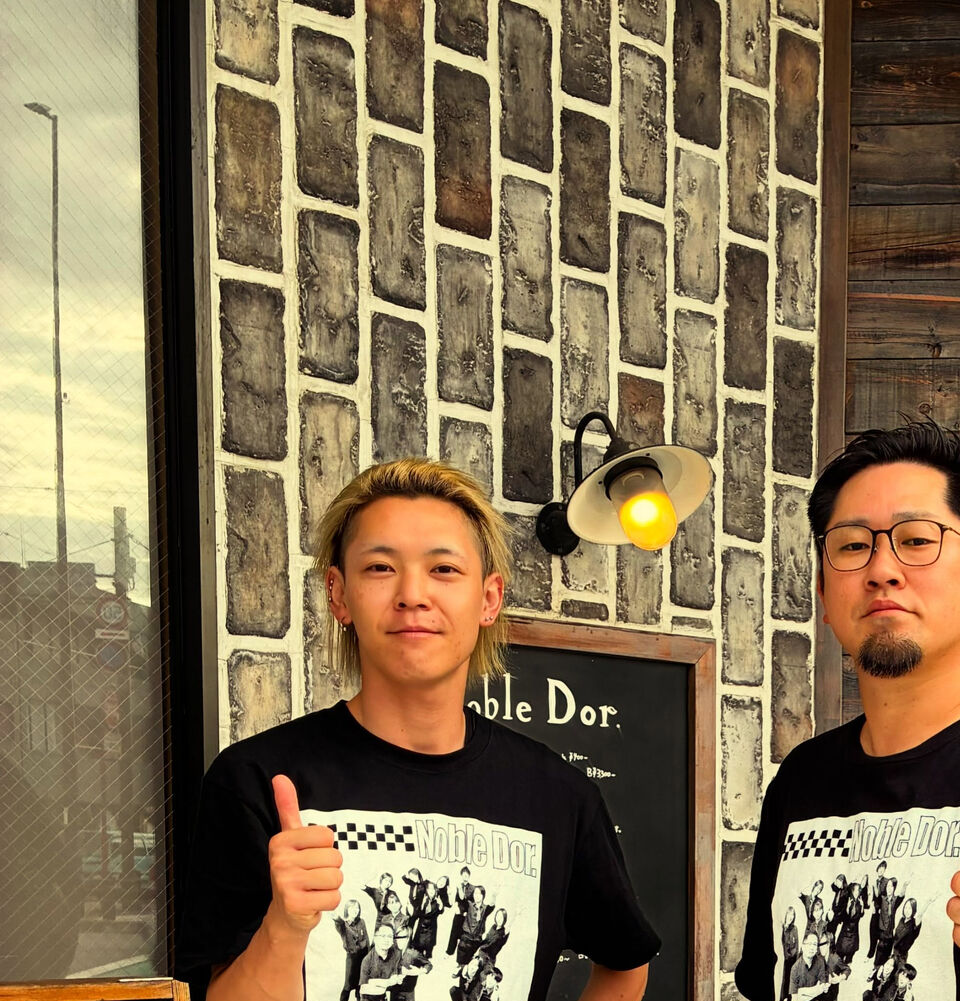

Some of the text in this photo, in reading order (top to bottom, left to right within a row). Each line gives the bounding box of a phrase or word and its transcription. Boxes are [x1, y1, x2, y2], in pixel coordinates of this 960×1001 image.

[546, 677, 621, 729] Dor.
[415, 819, 537, 878] Noble Dor.
[849, 816, 912, 863] Noble
